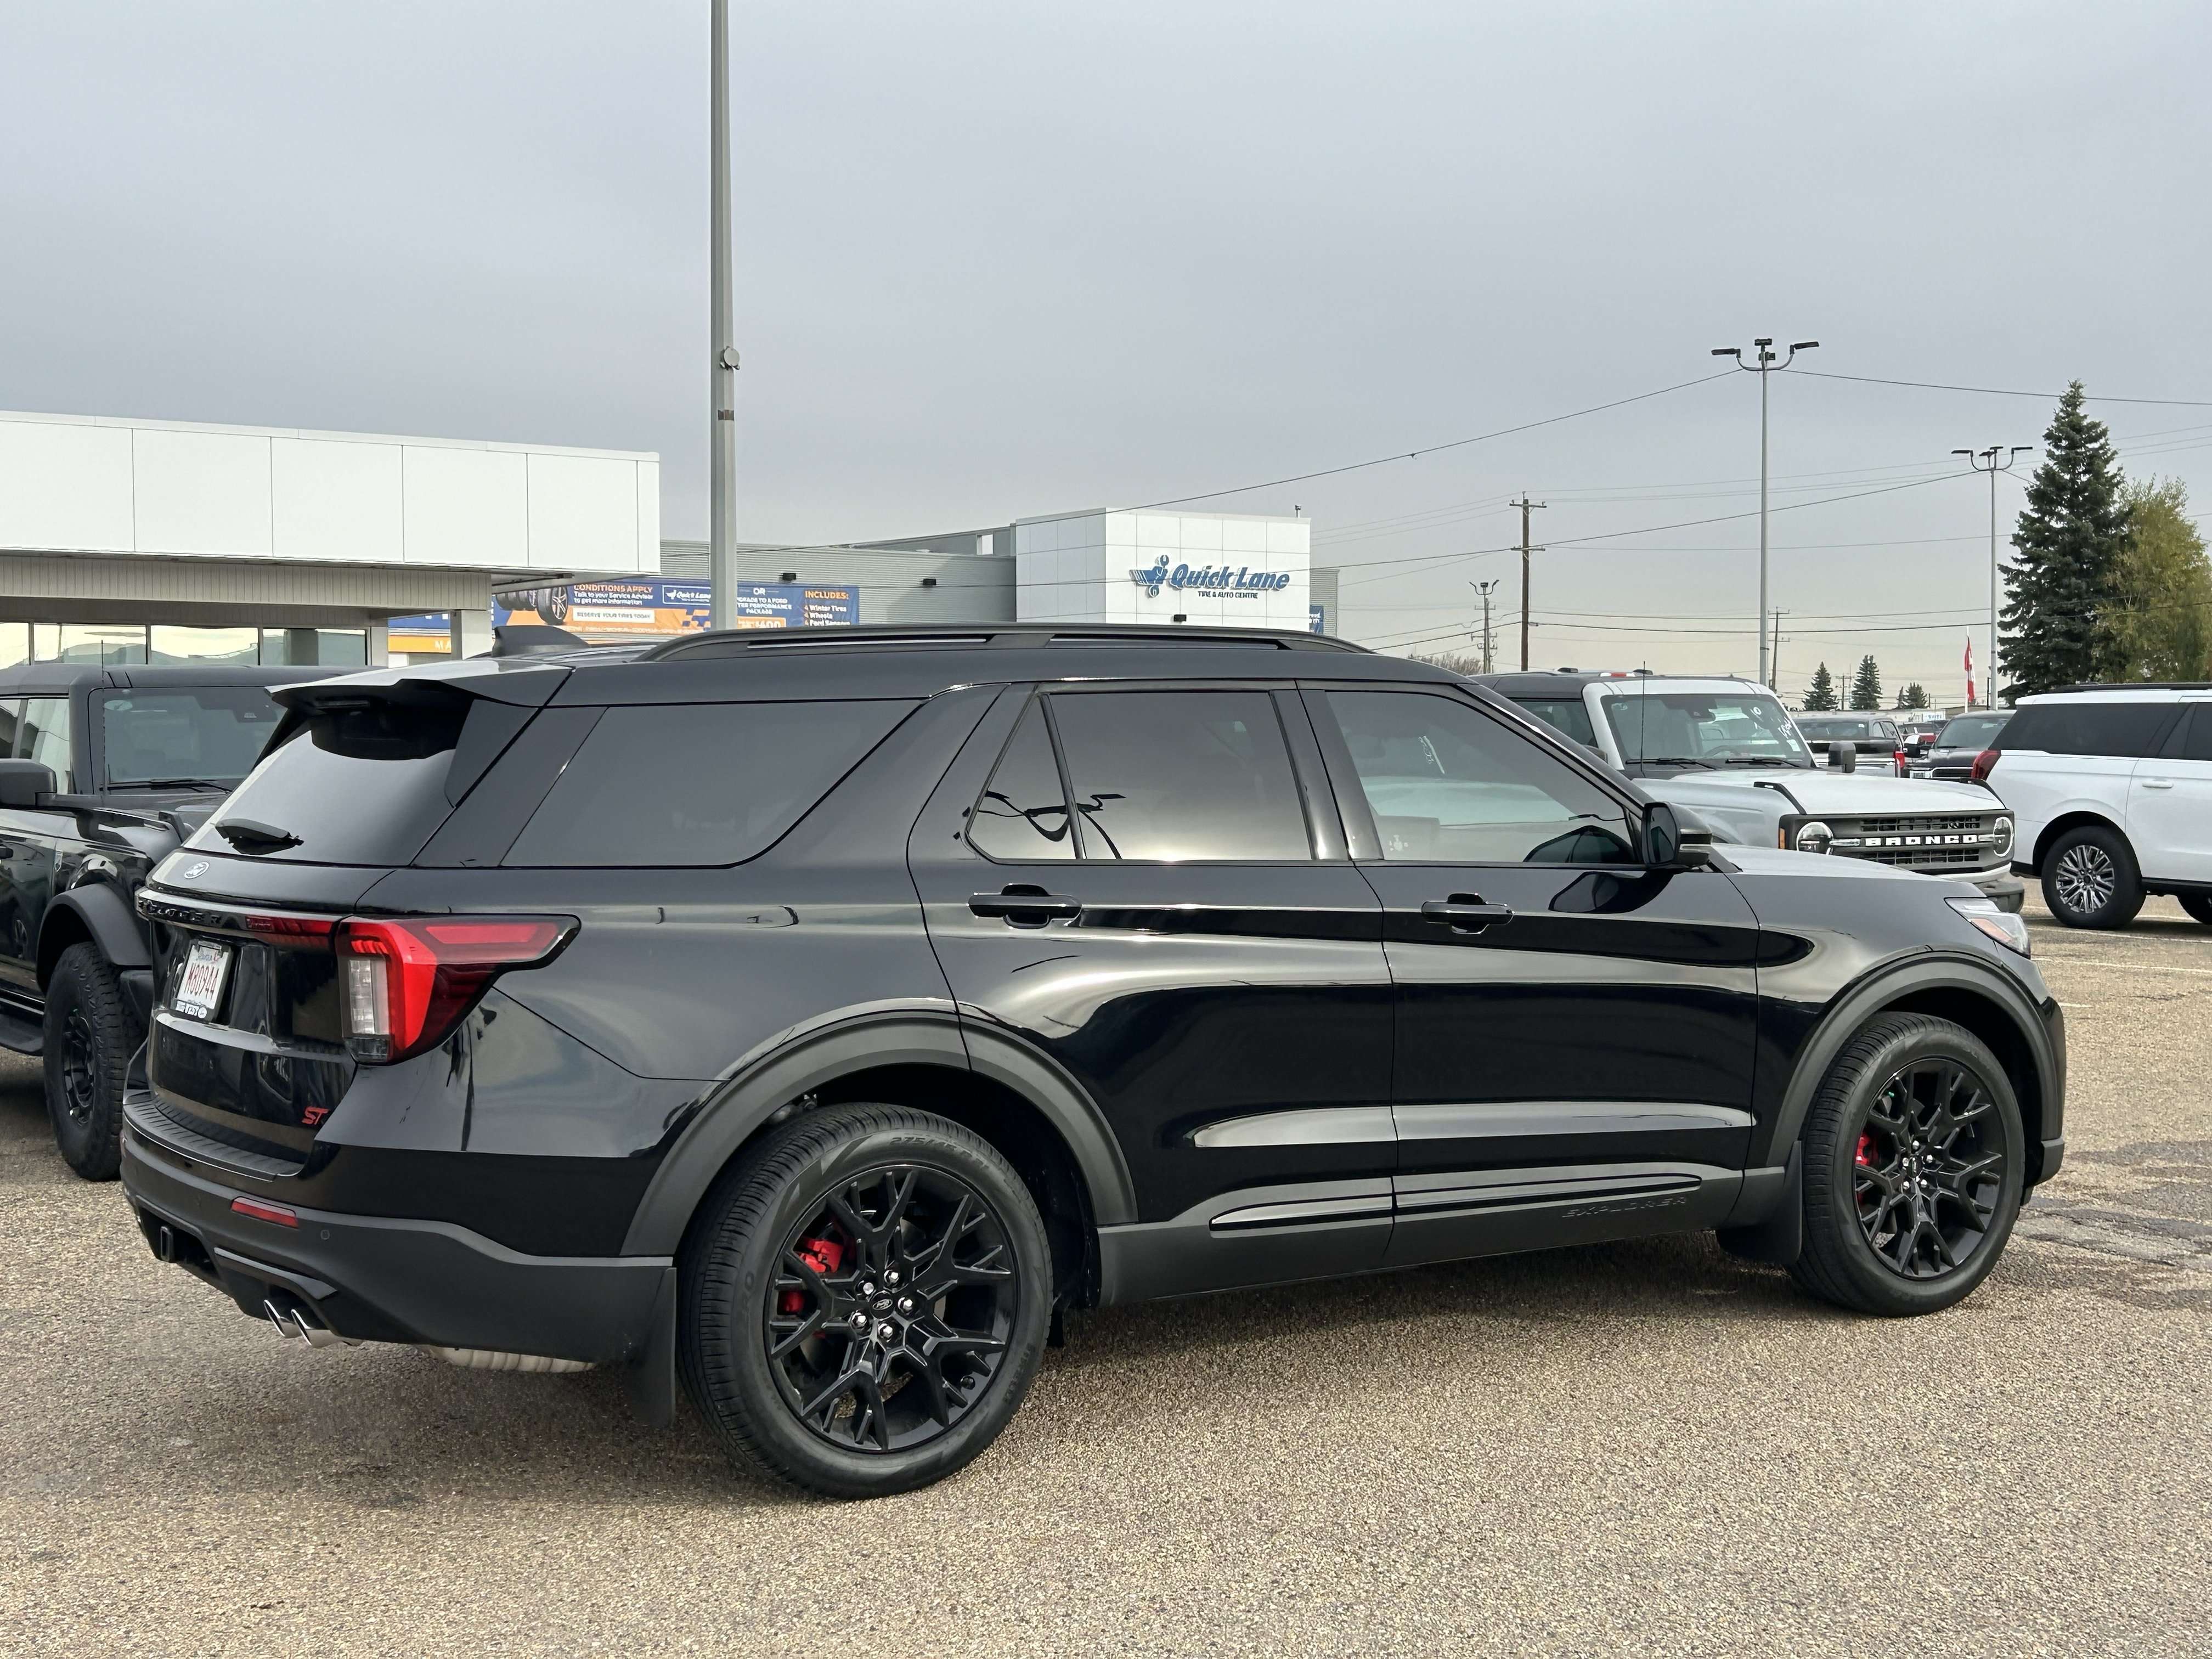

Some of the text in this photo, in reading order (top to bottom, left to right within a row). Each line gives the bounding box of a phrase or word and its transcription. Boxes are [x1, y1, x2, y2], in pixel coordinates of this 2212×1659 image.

[1171, 563, 1290, 589] Quick Lane
[574, 584, 625, 592] CONDITIONS
[805, 590, 849, 600] INCLUDES:
[1865, 834, 1977, 847] BRONCO
[302, 1106, 329, 1125] ST
